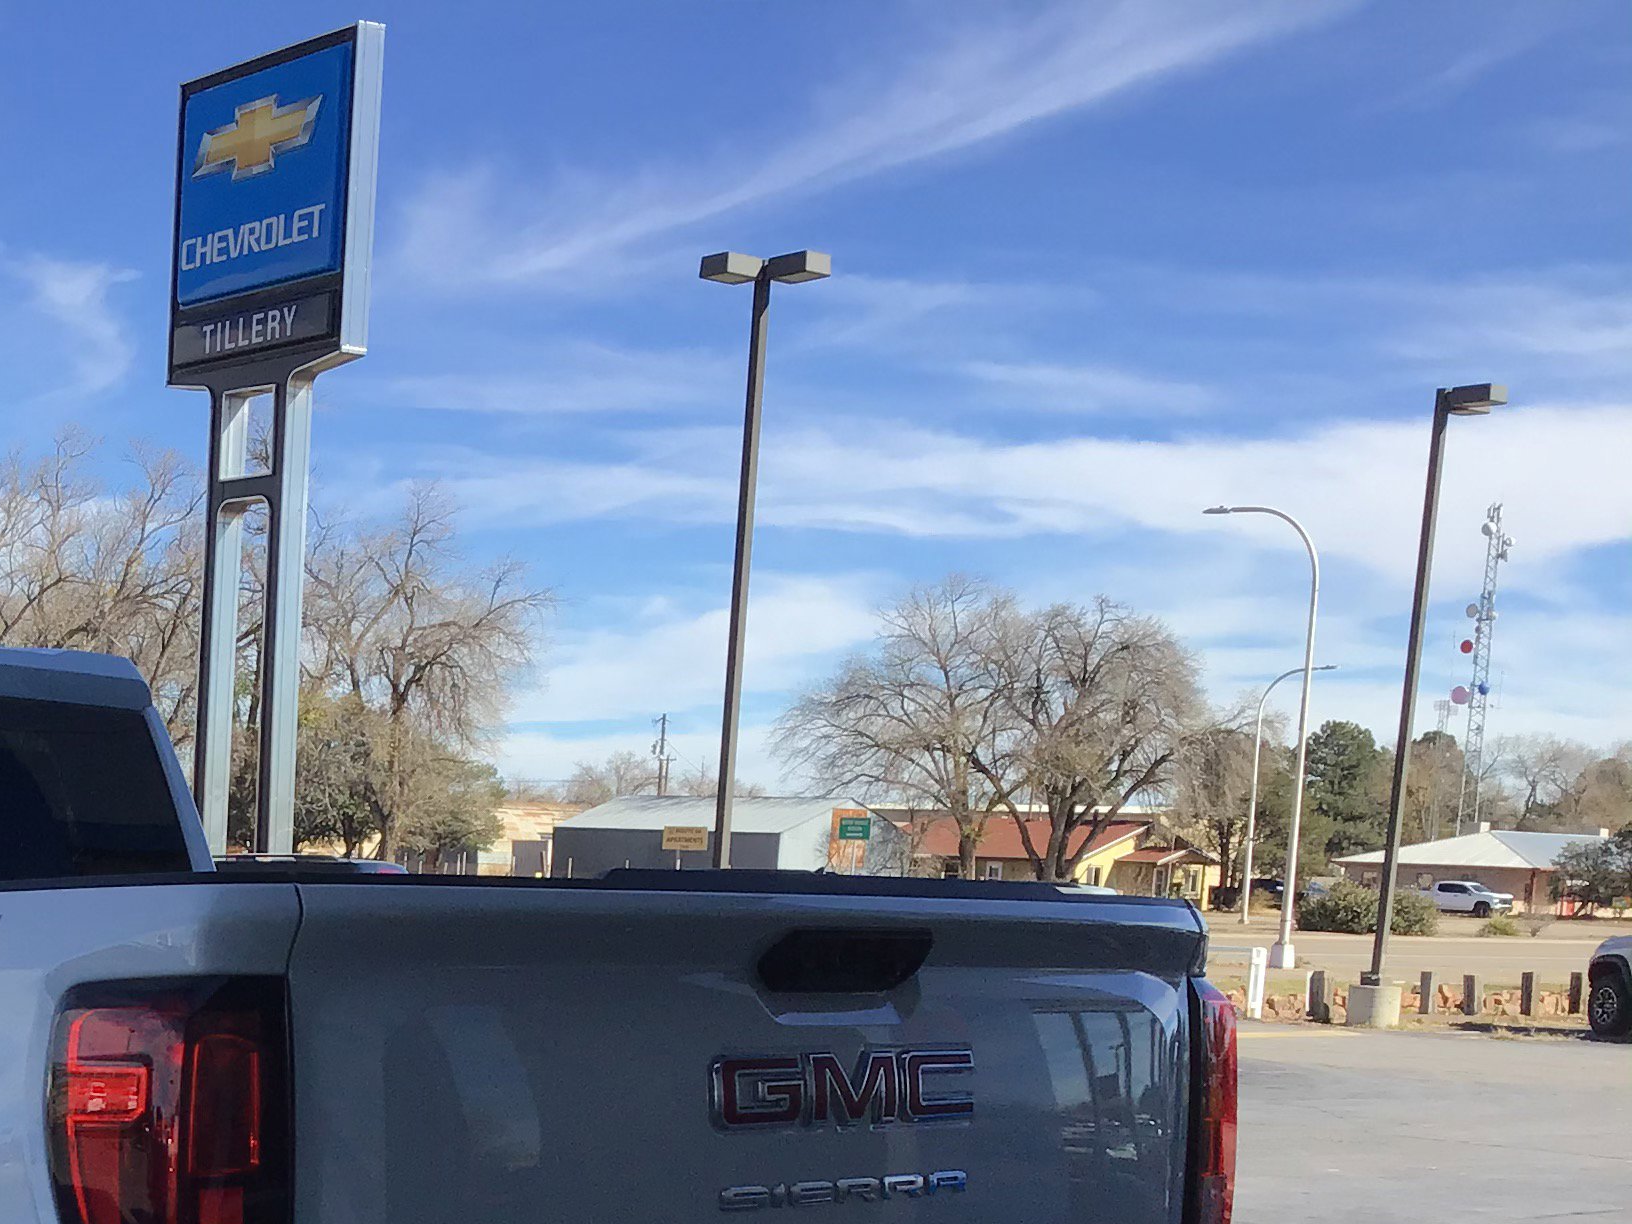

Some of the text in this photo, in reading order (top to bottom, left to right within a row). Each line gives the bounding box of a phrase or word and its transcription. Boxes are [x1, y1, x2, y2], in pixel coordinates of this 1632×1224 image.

[181, 203, 326, 271] CHEVROLET
[202, 305, 297, 354] TILLERY
[707, 1042, 976, 1136] GMC
[718, 1169, 969, 1212] SIERRA
